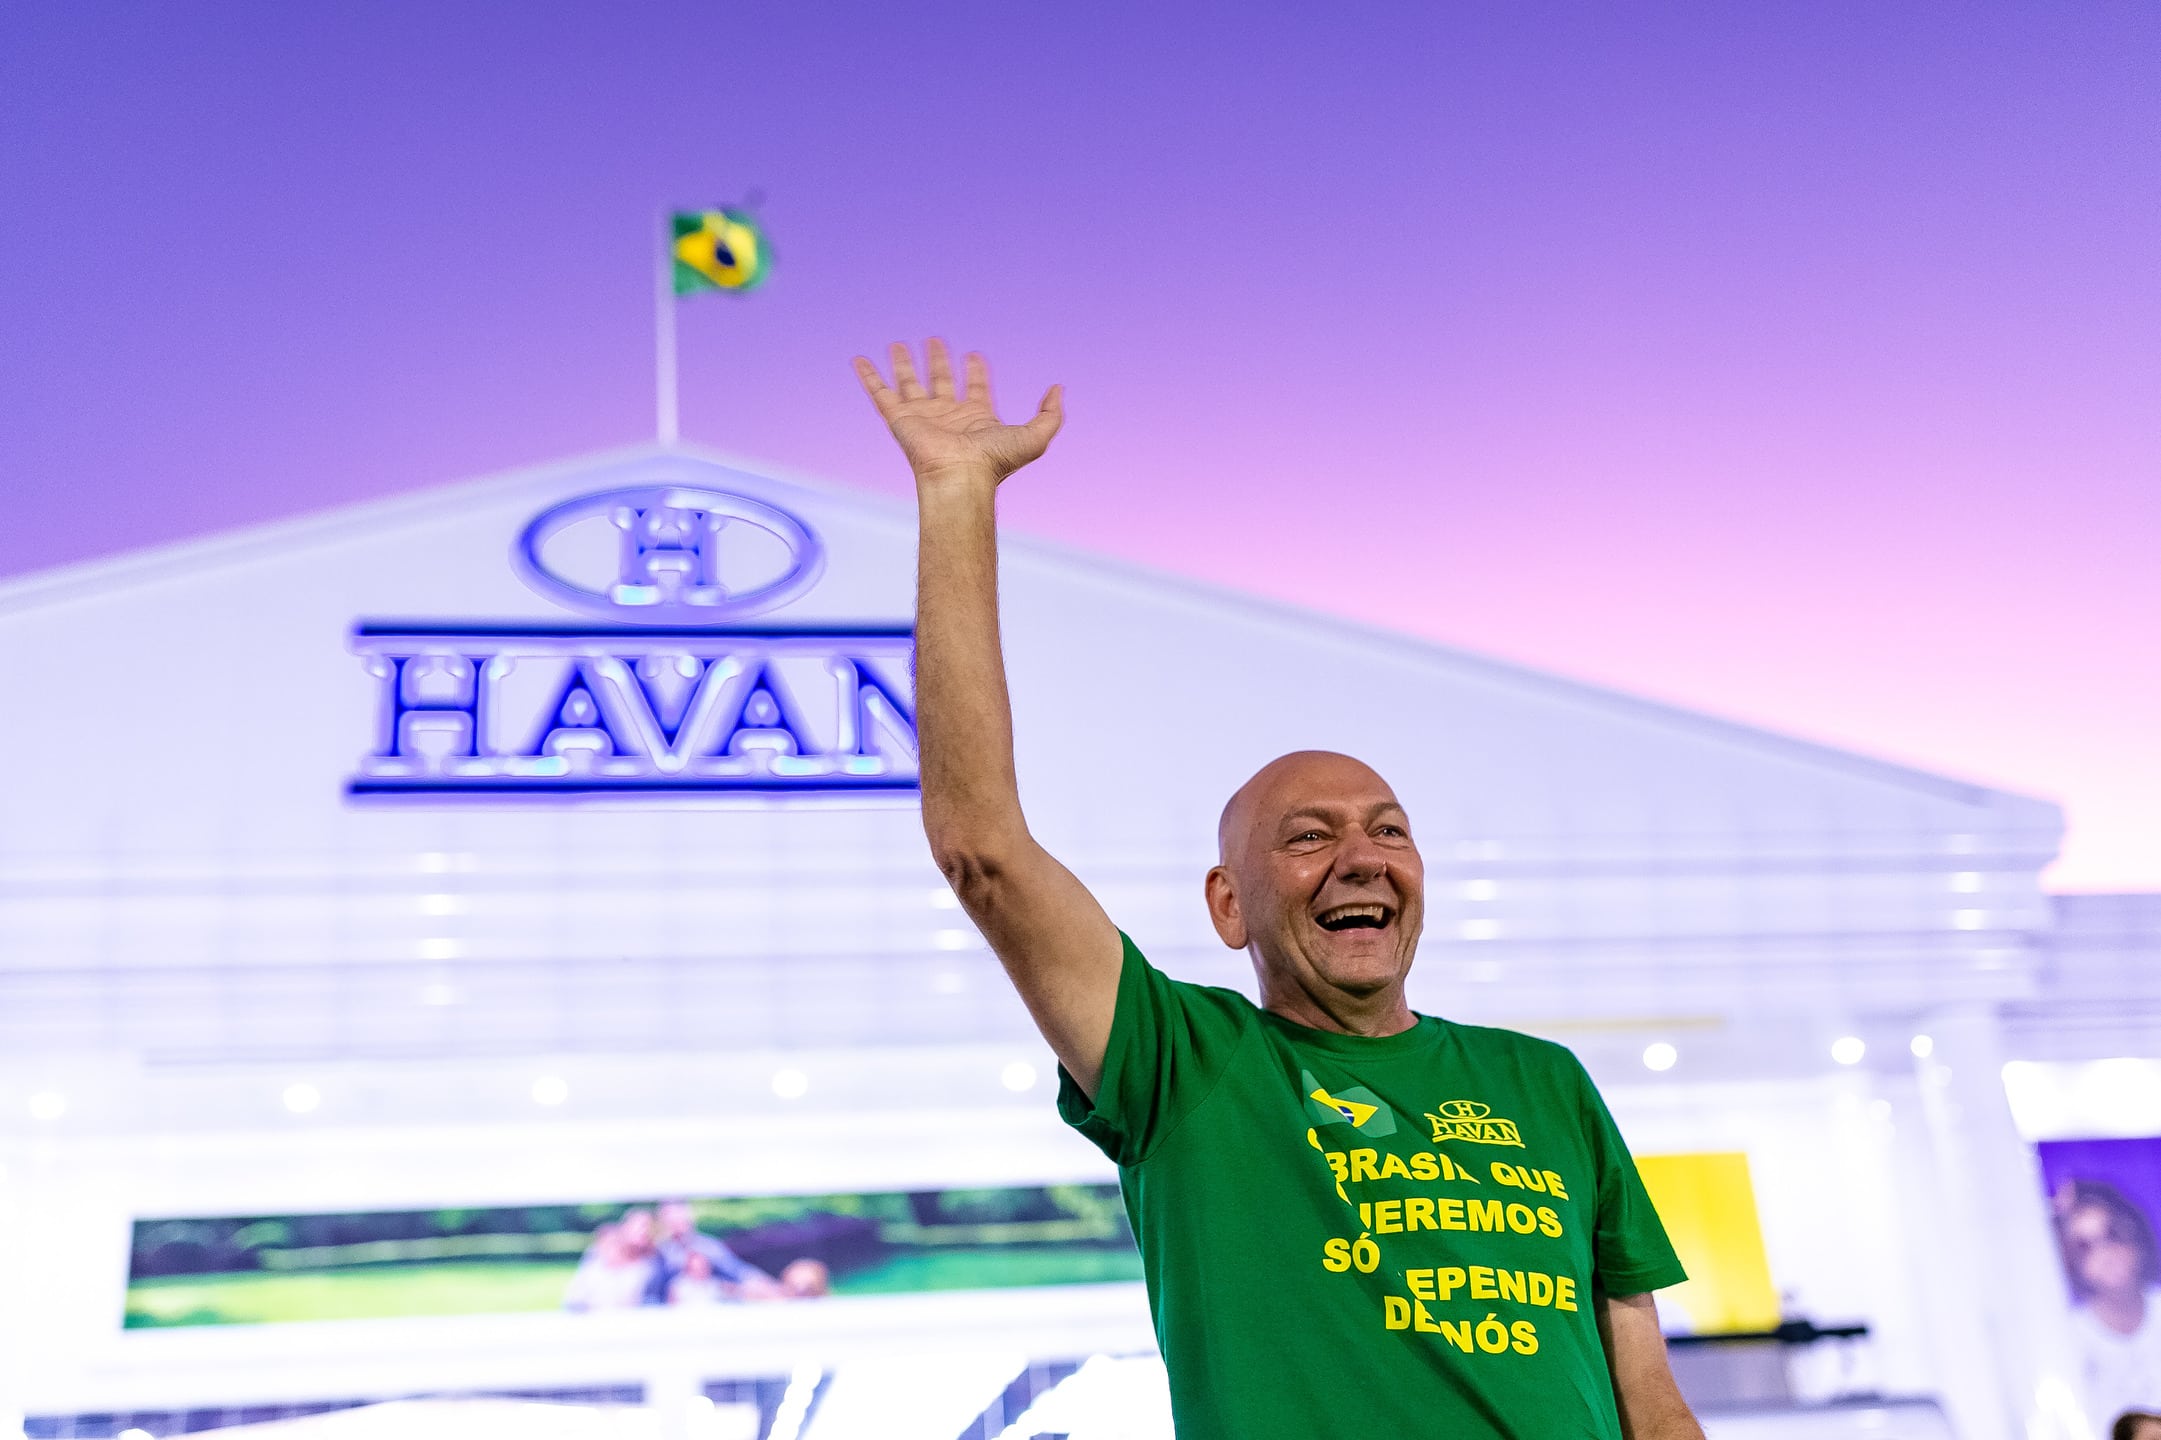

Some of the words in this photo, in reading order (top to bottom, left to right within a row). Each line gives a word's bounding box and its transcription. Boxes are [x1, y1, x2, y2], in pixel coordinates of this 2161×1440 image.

[607, 504, 730, 606] H
[1427, 1116, 1522, 1144] HAVAN
[1453, 1102, 1477, 1117] H
[1490, 1161, 1569, 1201] QUE
[1335, 1182, 1563, 1238] EREMOS
[1322, 1232, 1381, 1274] SÓ
[1404, 1265, 1578, 1312] EPENDE
[1383, 1295, 1441, 1334] DE
[1439, 1312, 1539, 1356] NÓS
